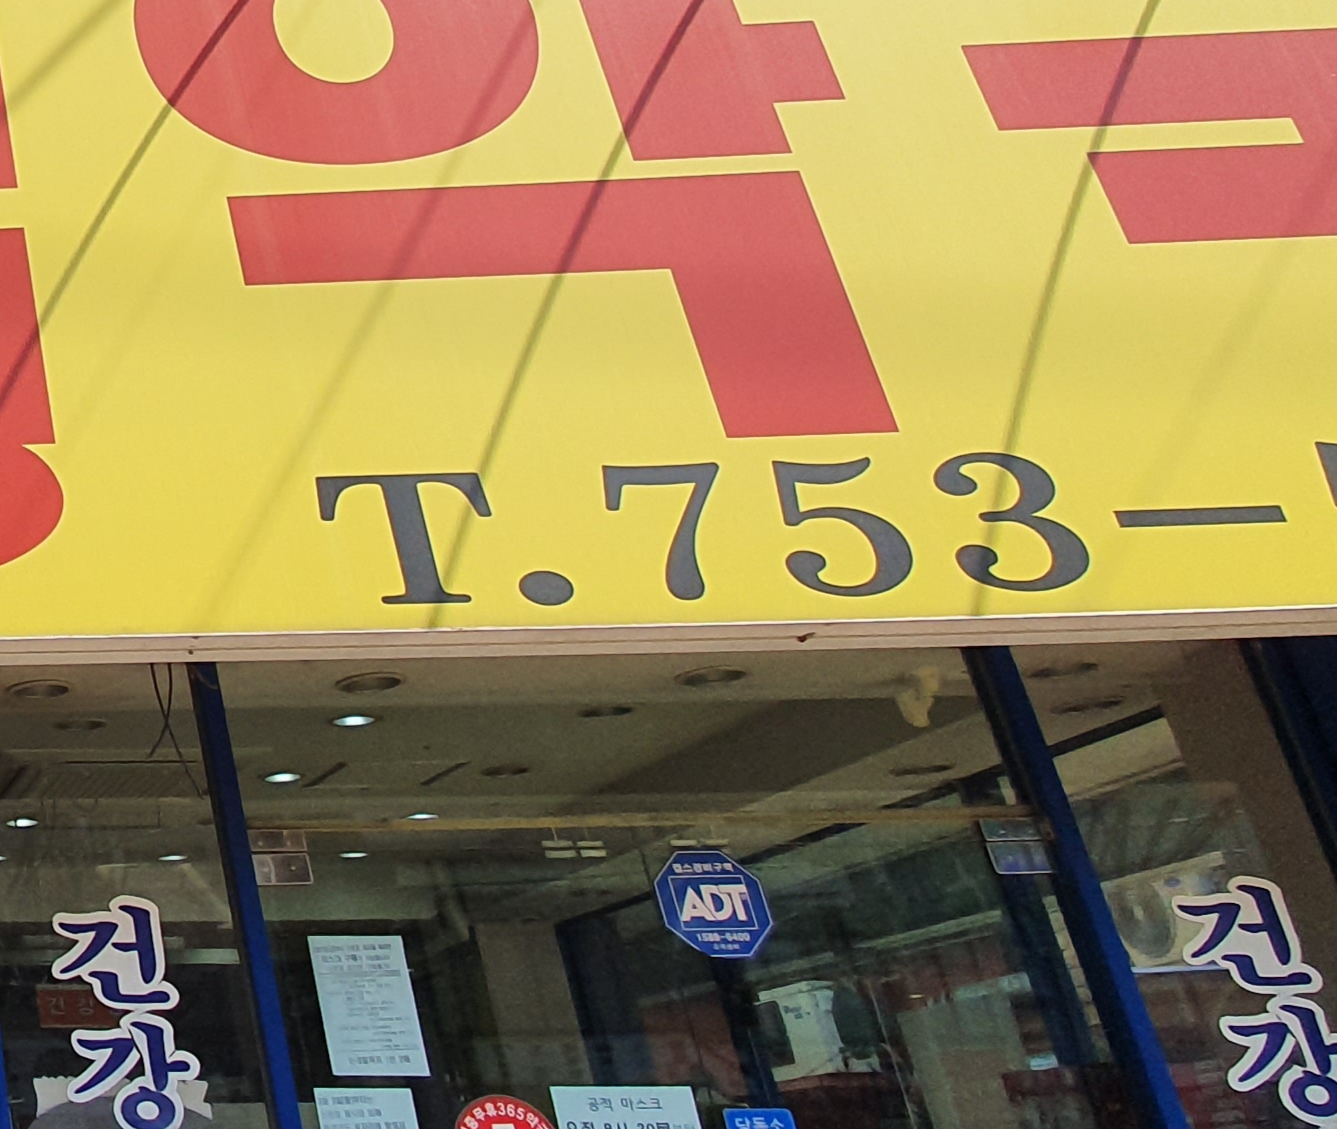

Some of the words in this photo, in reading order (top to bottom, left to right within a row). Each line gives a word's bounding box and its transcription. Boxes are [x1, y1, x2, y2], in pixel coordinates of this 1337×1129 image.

[315, 443, 1337, 605] T.753-
[681, 884, 749, 922] ADT
[52, 895, 200, 1129] 건강
[587, 1097, 614, 1112] 공적
[620, 1097, 663, 1112] 마스크
